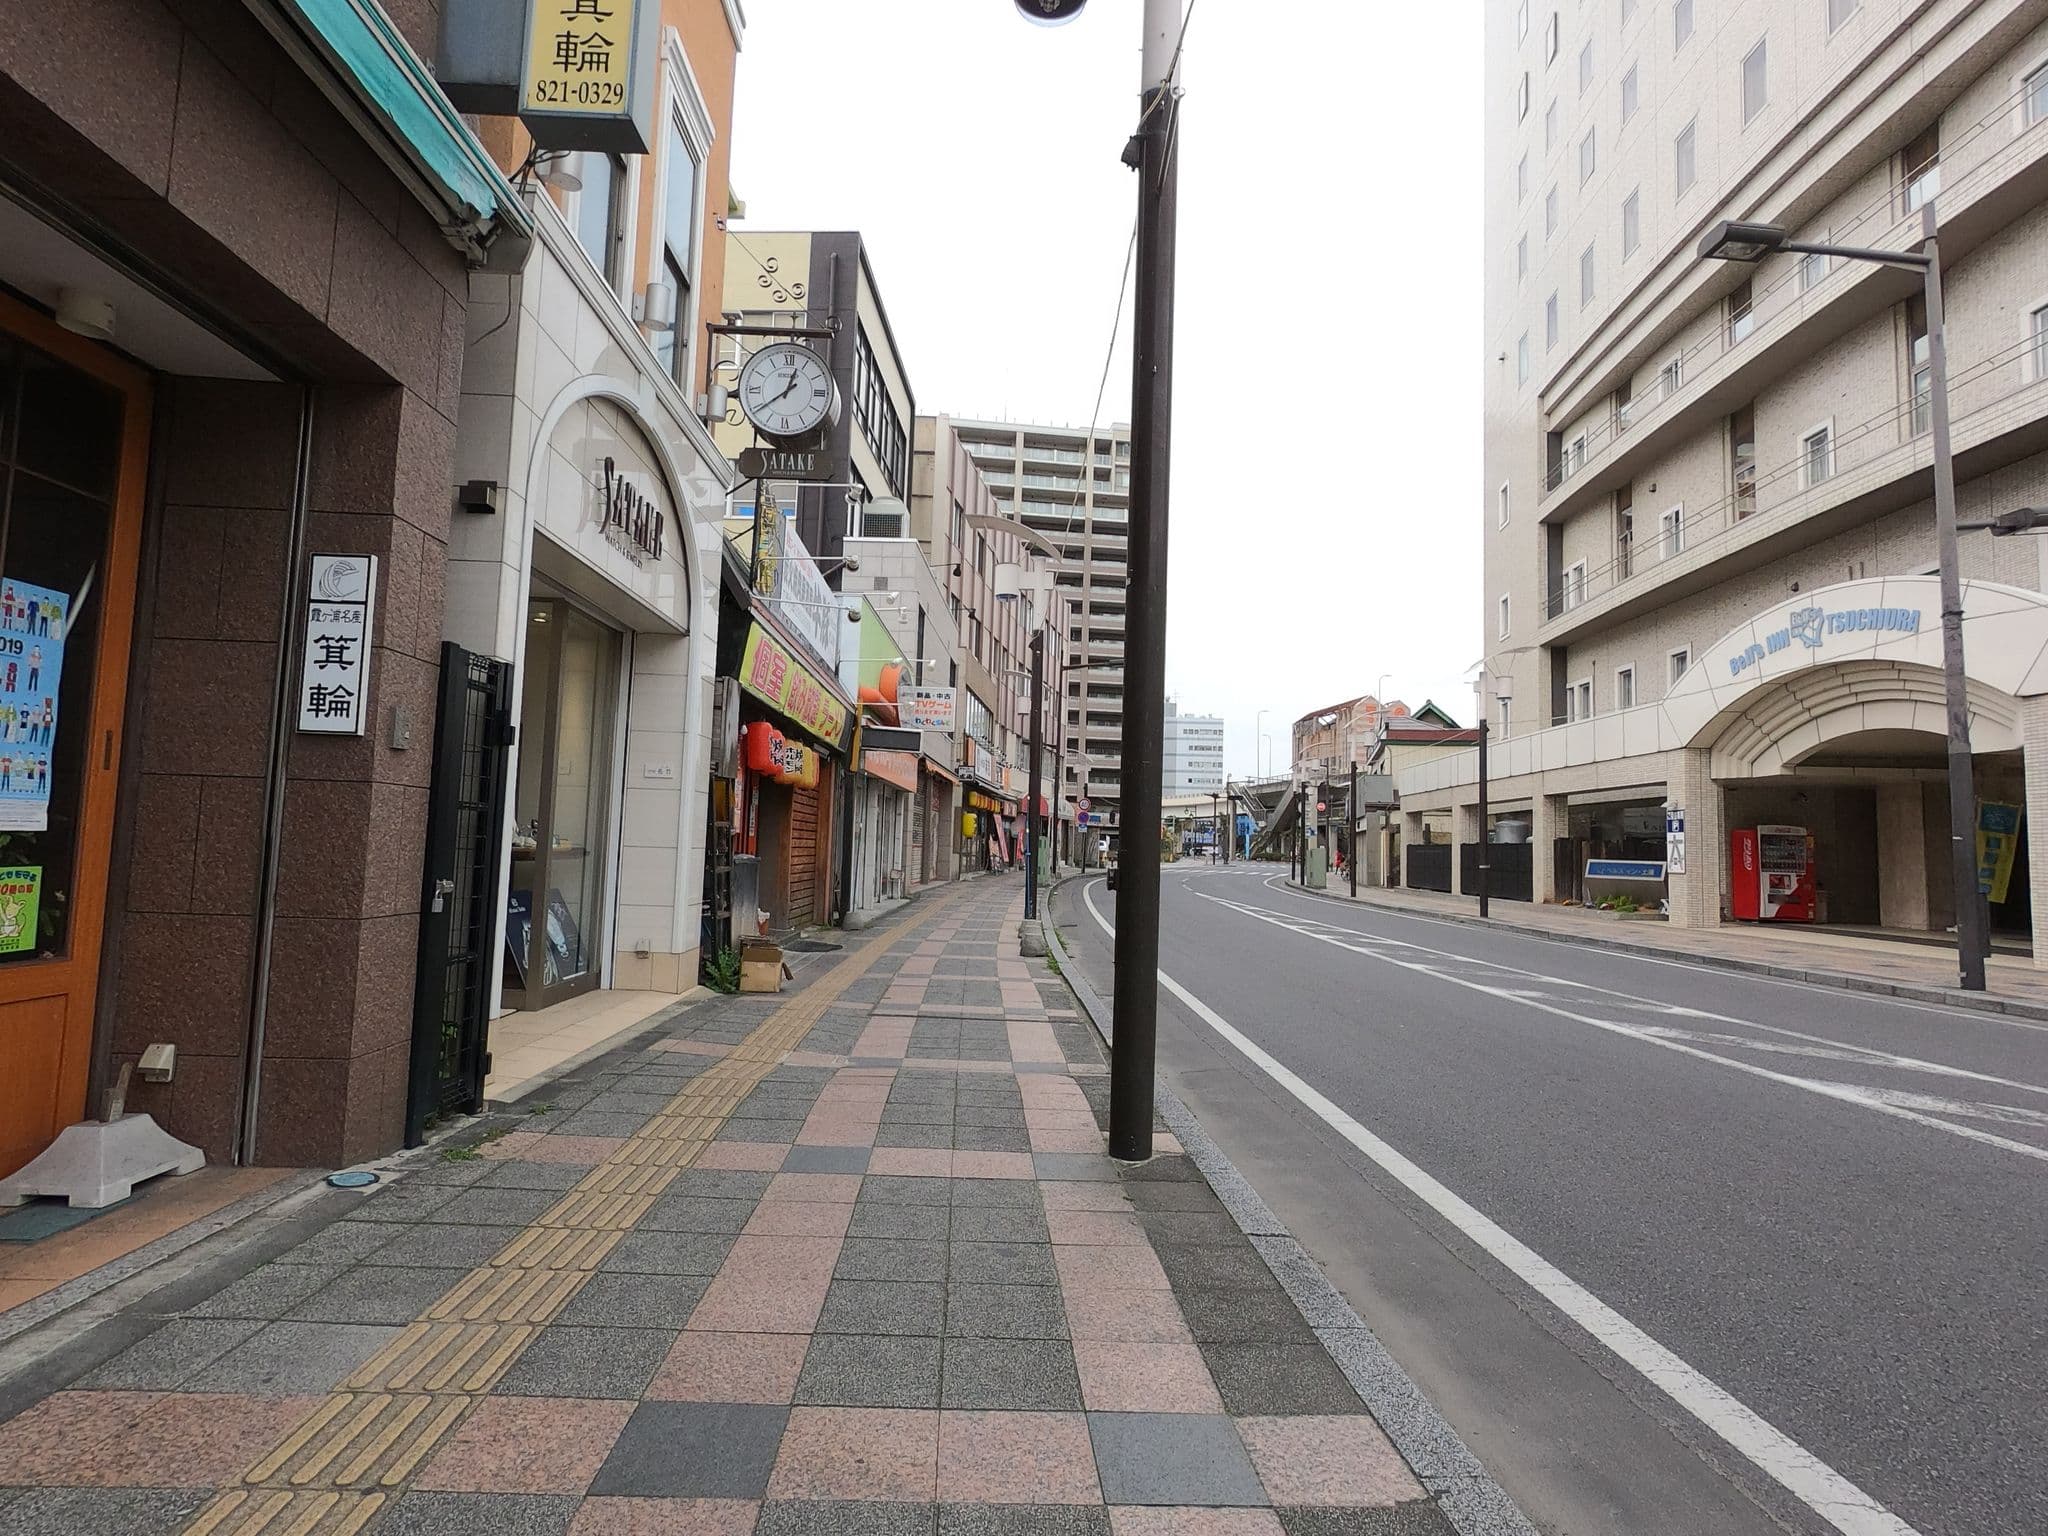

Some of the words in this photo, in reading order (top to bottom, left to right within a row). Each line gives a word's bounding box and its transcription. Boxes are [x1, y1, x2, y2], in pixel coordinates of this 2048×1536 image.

[535, 79, 625, 106] 821-0329
[760, 450, 816, 477] SATAKE
[1825, 607, 1921, 635] TSUCHIURA
[1766, 628, 1791, 655] INN
[306, 633, 359, 719] 箕輪
